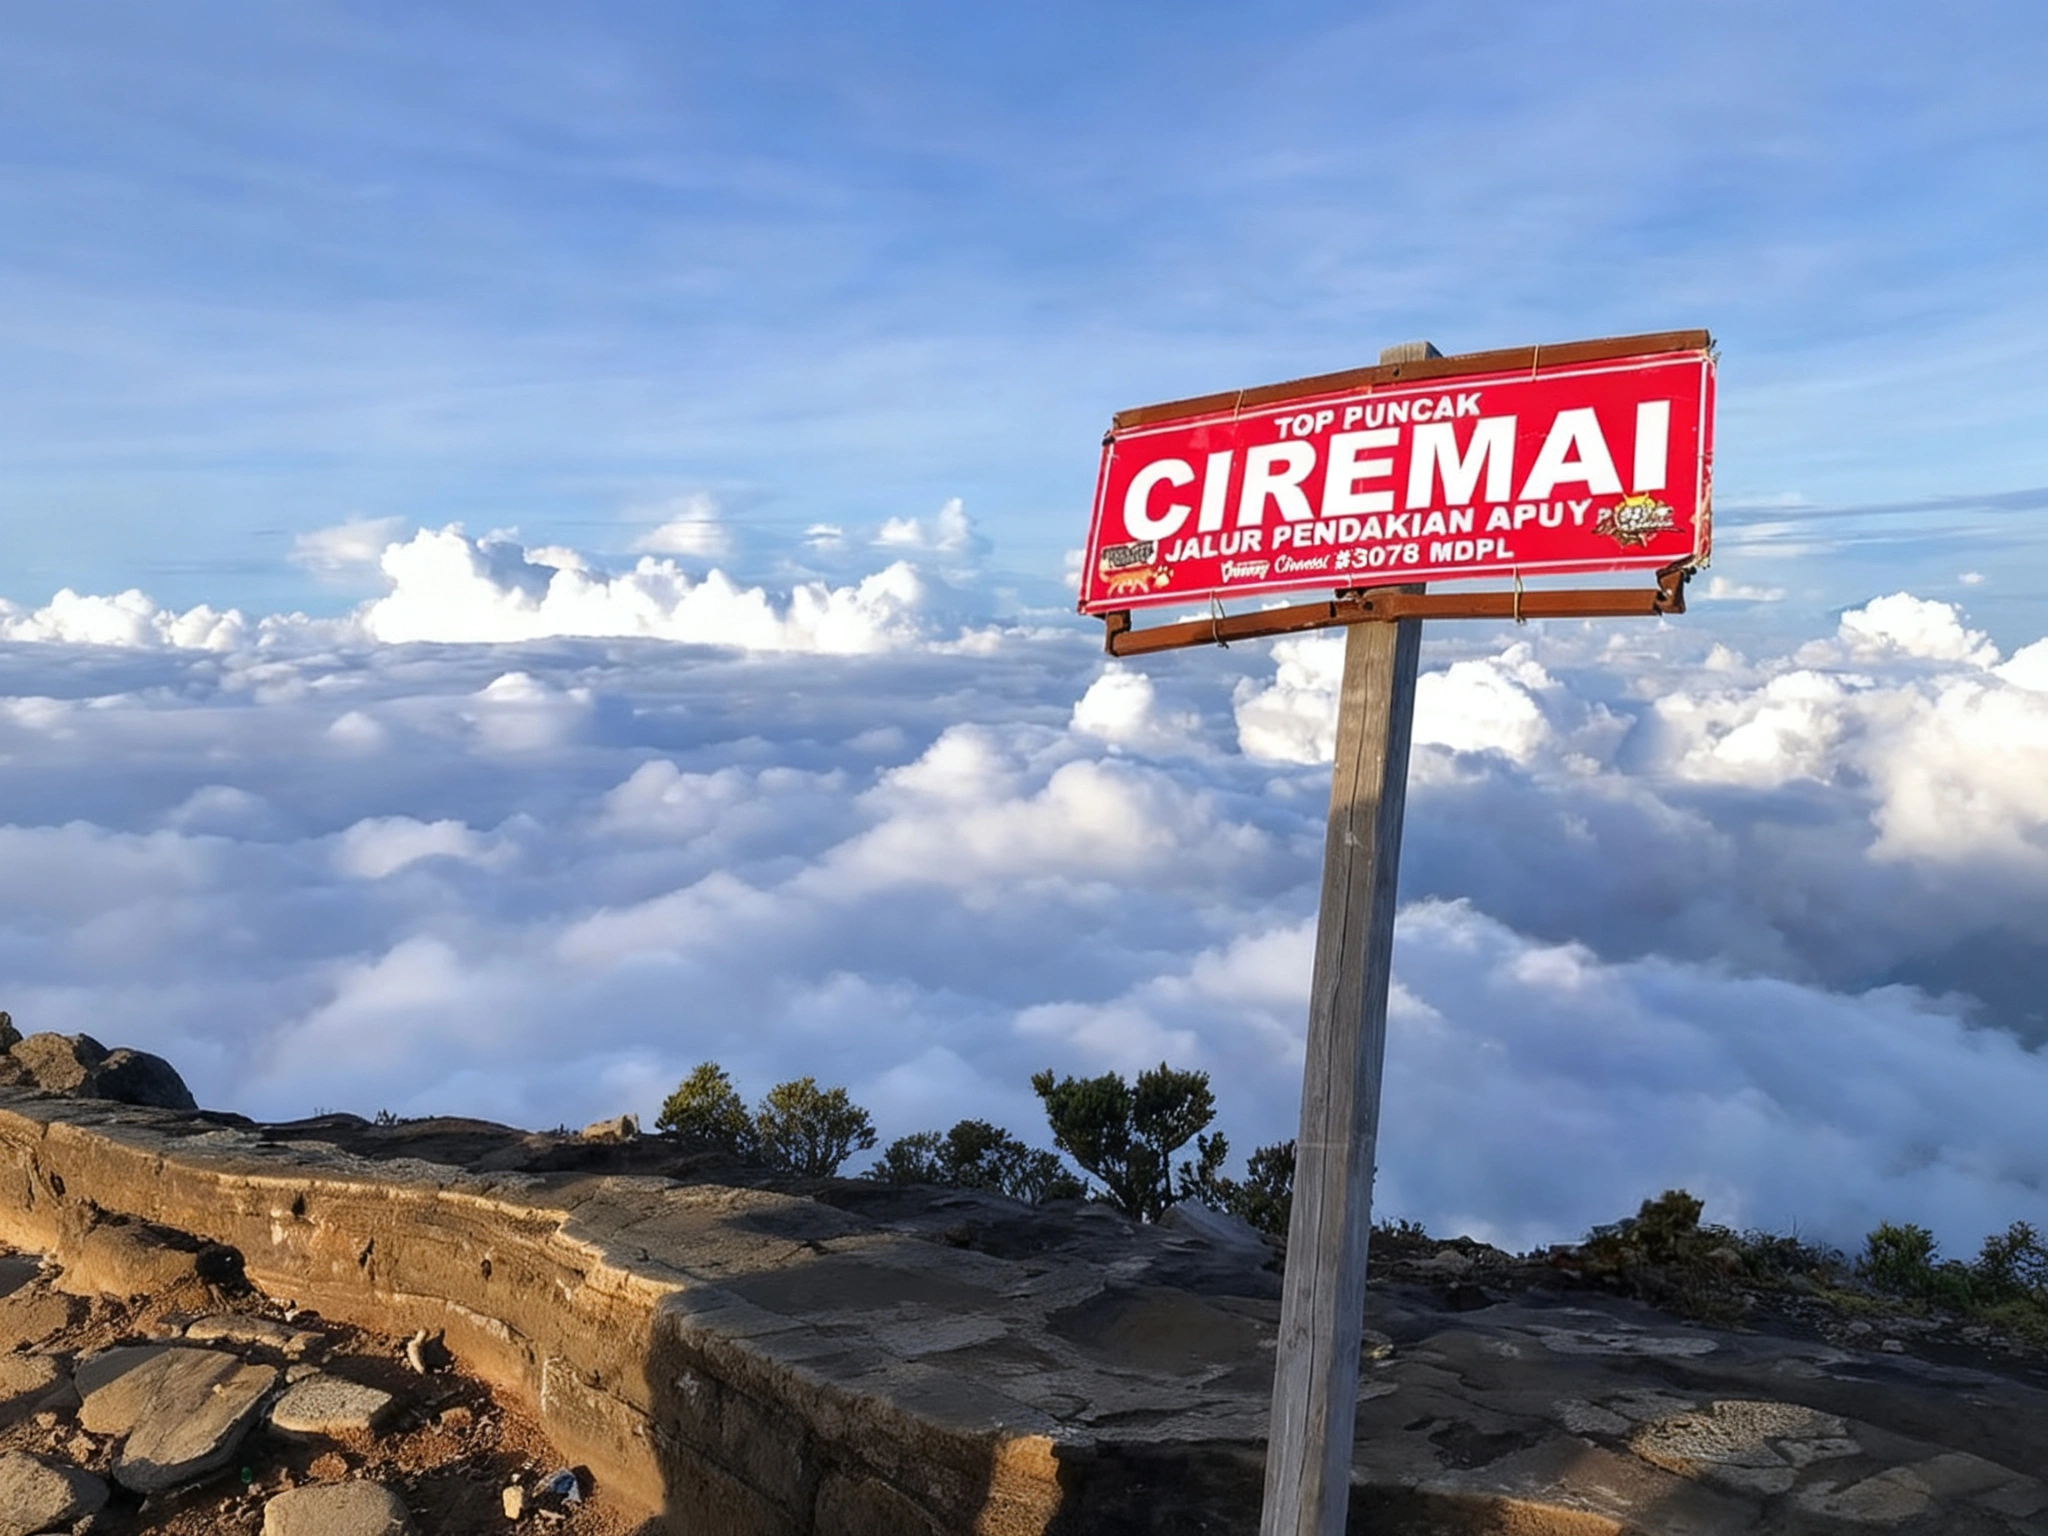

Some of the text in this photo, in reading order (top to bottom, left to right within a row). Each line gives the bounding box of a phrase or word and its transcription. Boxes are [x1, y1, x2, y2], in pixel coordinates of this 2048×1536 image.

[1274, 392, 1482, 439] TOP PUNCAK
[1122, 400, 1671, 541] CIREMAI
[1164, 528, 1263, 563] JALUR
[1271, 507, 1475, 550] PENDAKIAN
[1485, 498, 1593, 534] APUY
[1429, 537, 1515, 564] MDPL
